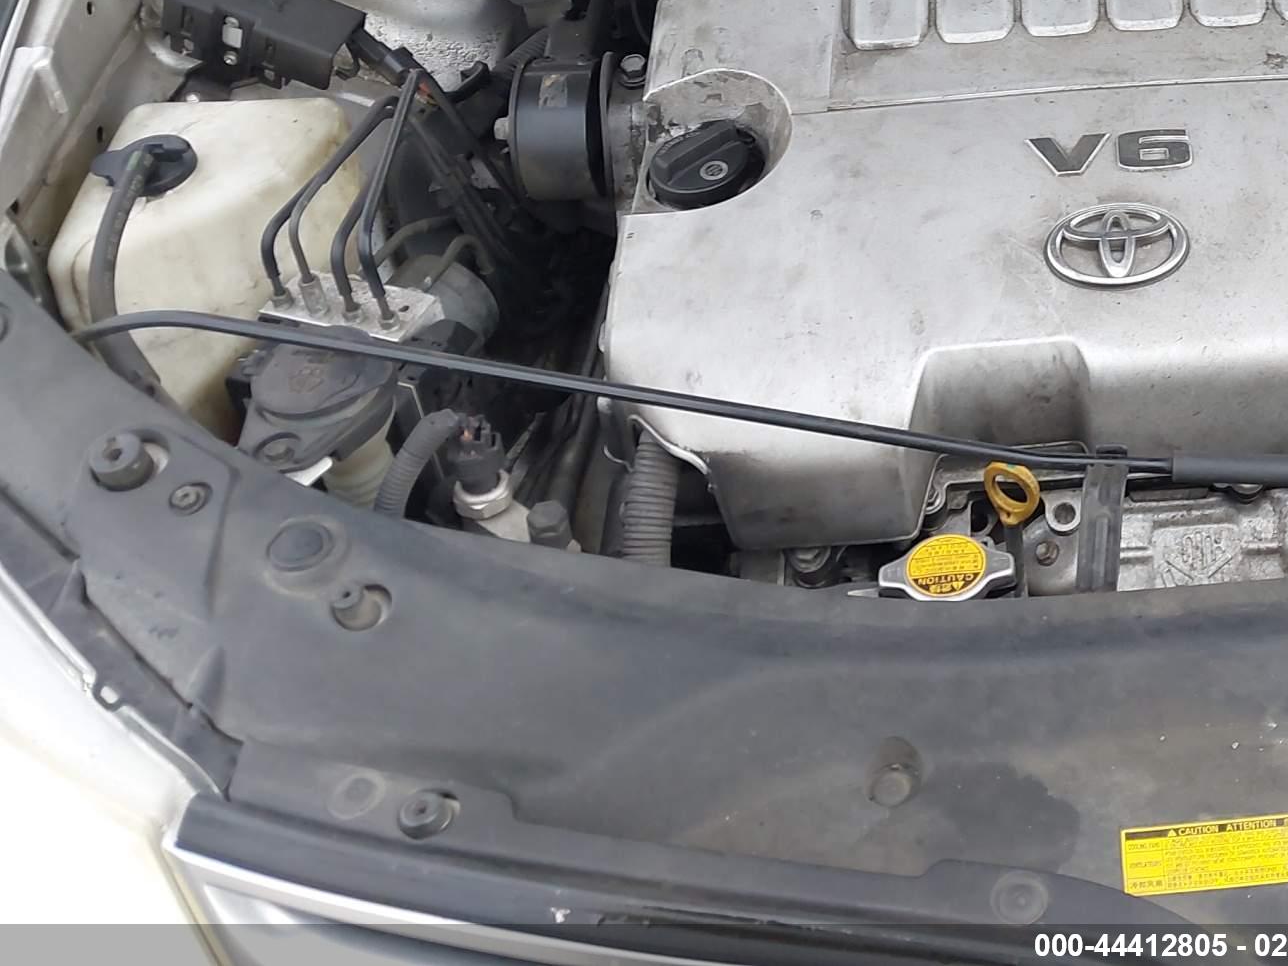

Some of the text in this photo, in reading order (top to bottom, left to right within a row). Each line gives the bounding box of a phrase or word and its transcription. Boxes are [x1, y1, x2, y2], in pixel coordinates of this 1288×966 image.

[1024, 128, 1193, 177] V6
[917, 573, 975, 586] CAUTION
[1178, 825, 1220, 836] CAUTION
[1225, 818, 1277, 832] ATTENTION
